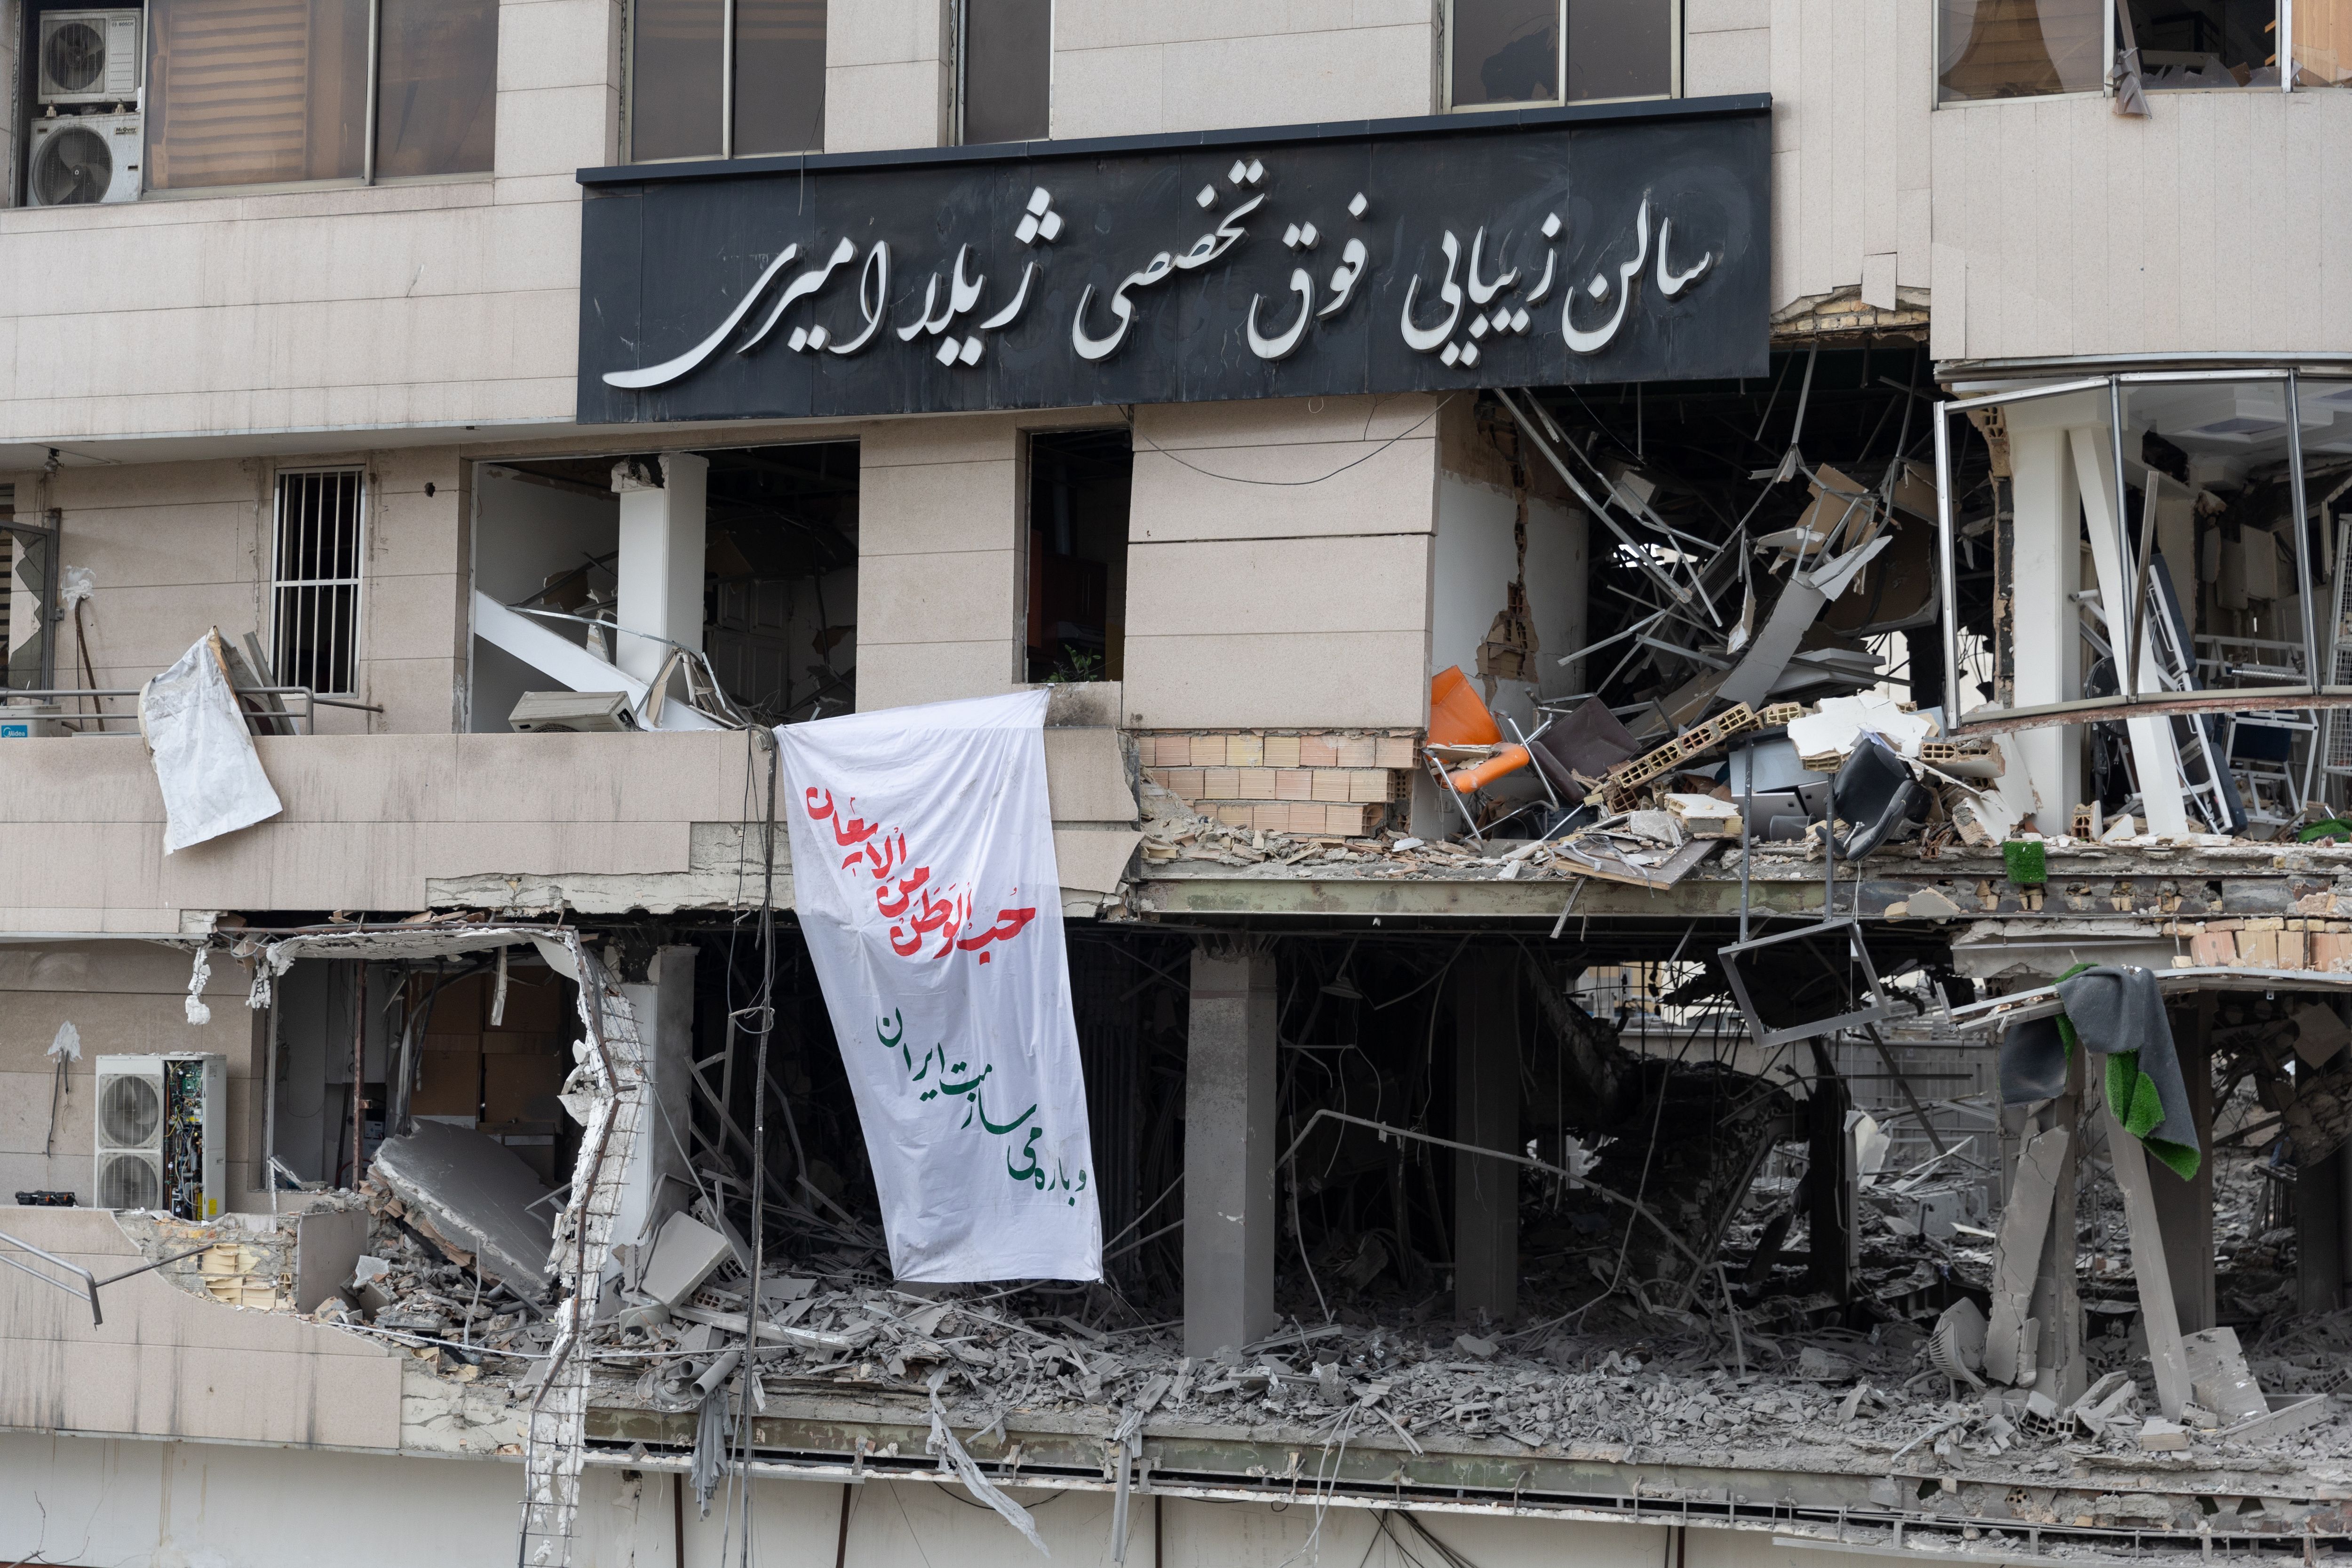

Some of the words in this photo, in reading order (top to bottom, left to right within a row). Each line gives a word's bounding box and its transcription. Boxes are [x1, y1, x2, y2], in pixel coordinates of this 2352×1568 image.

[1072, 158, 1266, 361] تخصصی
[1247, 191, 1369, 360] فوق
[1400, 212, 1562, 368] زیبایی
[1562, 198, 1713, 354] سالن
[875, 1006, 946, 1102] ایران
